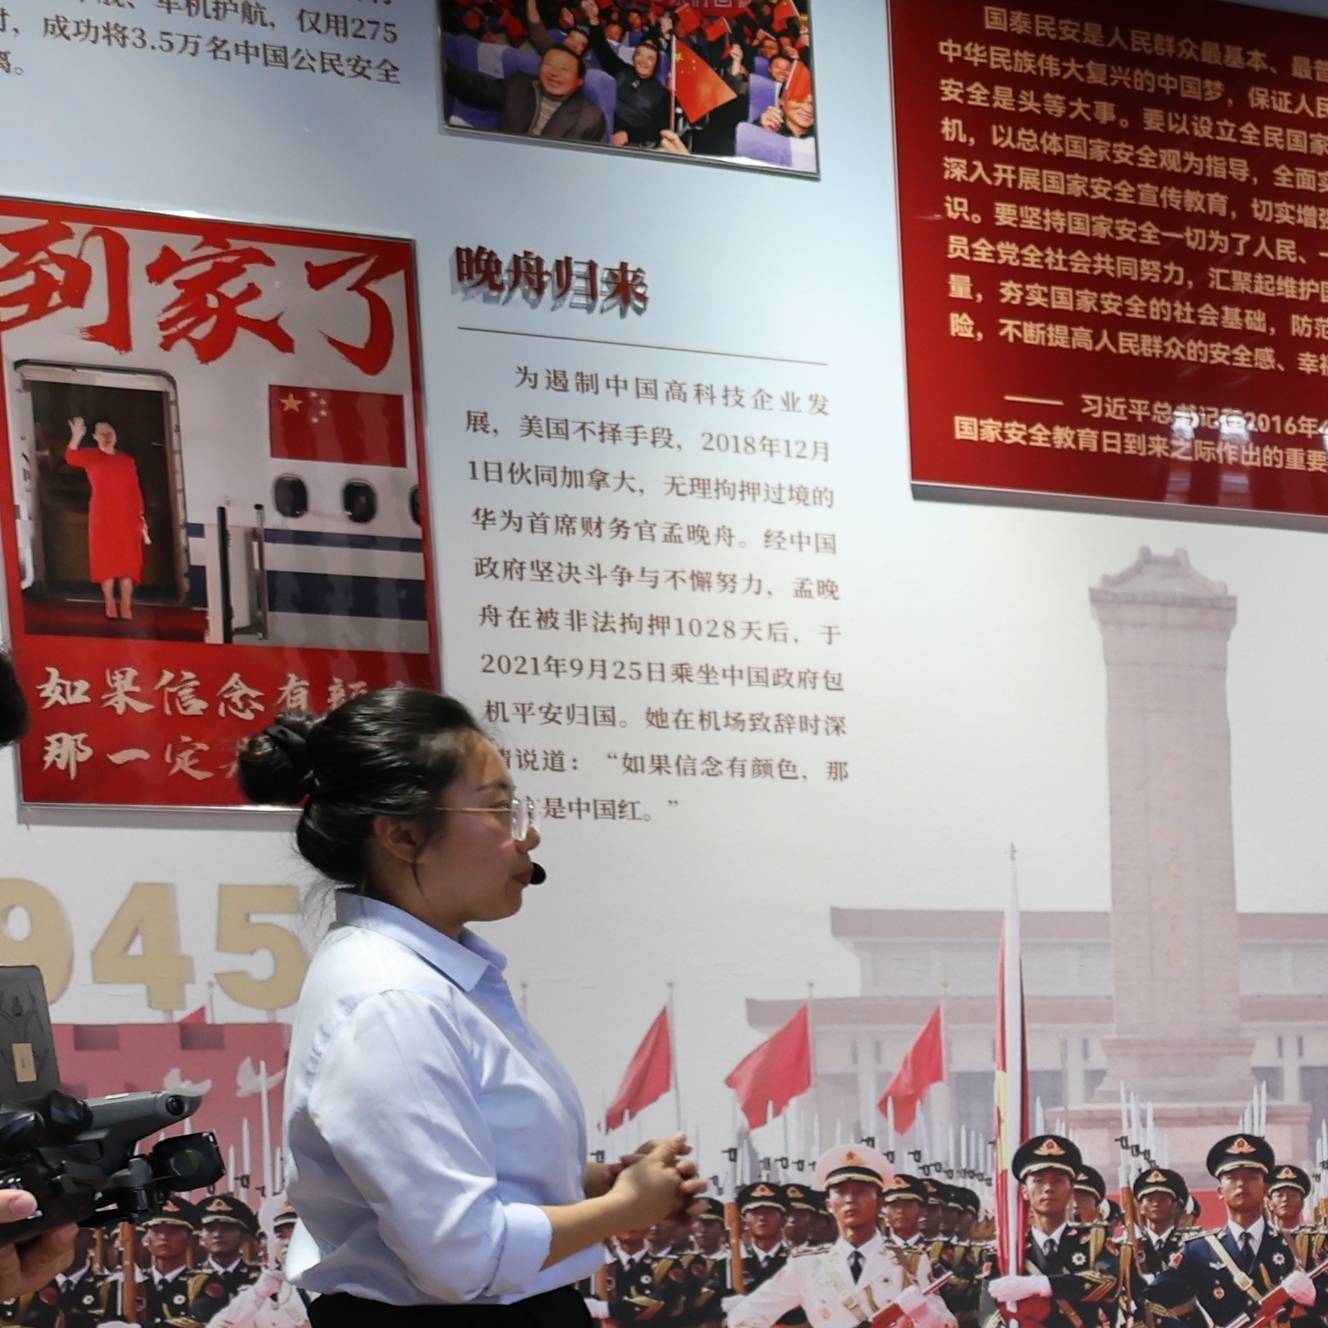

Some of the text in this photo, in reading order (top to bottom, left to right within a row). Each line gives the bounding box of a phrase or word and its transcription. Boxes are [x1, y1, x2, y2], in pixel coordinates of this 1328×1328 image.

[0, 8, 401, 85] ，成功将3.5万名中国公民安全
[0, 216, 405, 377] 到家了
[455, 244, 650, 308] 晚舟归来
[513, 365, 831, 416] 为遏制中国高科技企业发
[465, 409, 831, 463] 展，美国不择手段，2018年12月
[467, 460, 835, 508] 1日伙同加拿大，无理拘押过境的
[471, 507, 838, 555] 华为首席财务官孟晚舟。经中国
[474, 556, 841, 601] 政府坚决斗争与不懈努力，孟晚
[478, 603, 843, 646] 舟在被非法拘押1028天后，于
[480, 652, 845, 693] 2021年9月25日乘坐中国政府包
[484, 700, 848, 737] 机平安归国。她在机场致辞时深
[43, 732, 239, 780] 那一定
